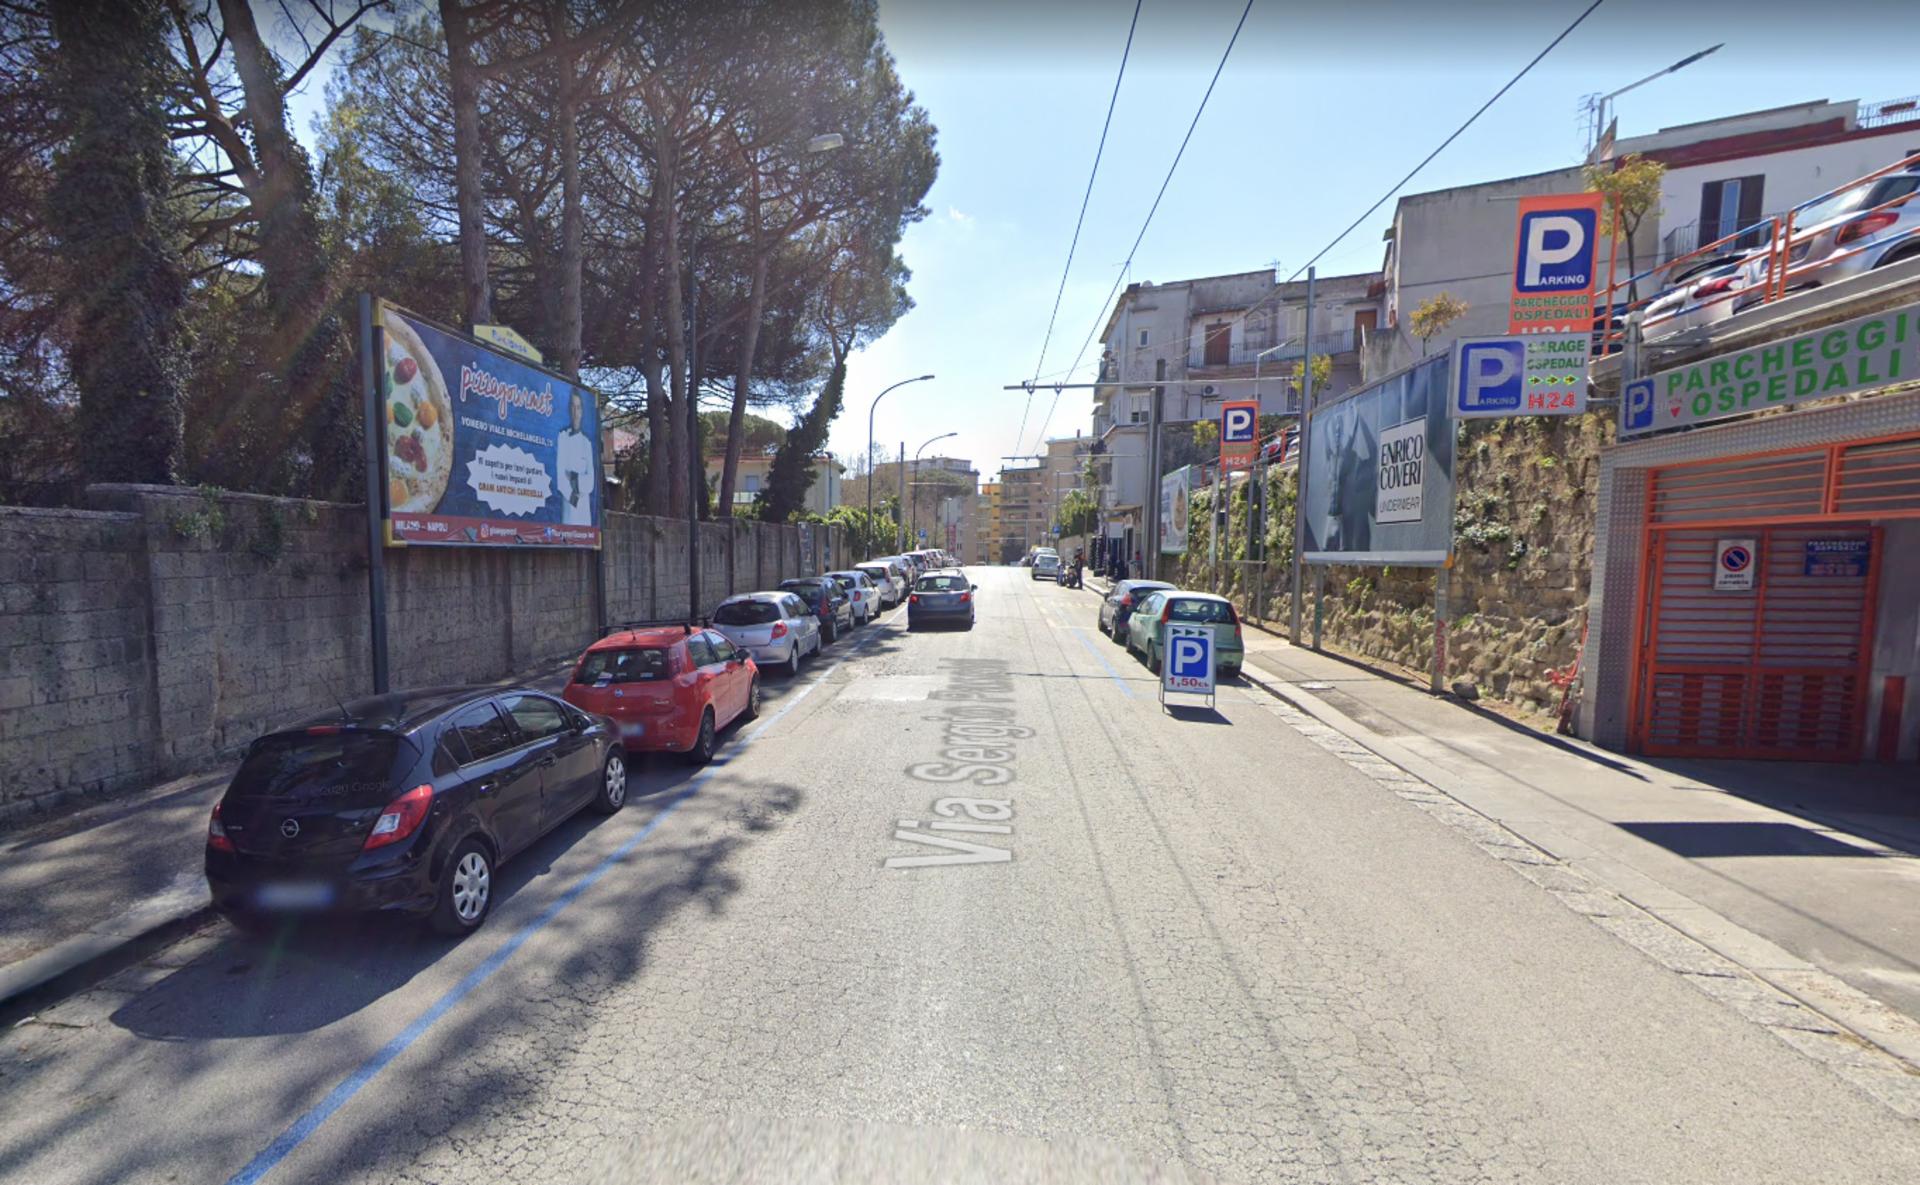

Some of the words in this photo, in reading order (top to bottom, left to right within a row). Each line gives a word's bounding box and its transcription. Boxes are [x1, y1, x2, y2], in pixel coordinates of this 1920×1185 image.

[1524, 216, 1585, 286] PARKING
[1513, 295, 1589, 308] PARCHEGGIO
[1513, 308, 1590, 321] OSPEDALI
[1526, 358, 1585, 370] OSPEDALI
[1667, 313, 1920, 396] PARCHEGGI
[460, 361, 553, 420] pizzagourmet
[1691, 348, 1901, 417] OSPEDALI
[1527, 391, 1576, 410] H24
[1381, 434, 1423, 466] ENRICO
[1380, 460, 1422, 490] COVERI
[1380, 496, 1421, 513] UNDERWEAR
[1175, 640, 1203, 673] P
